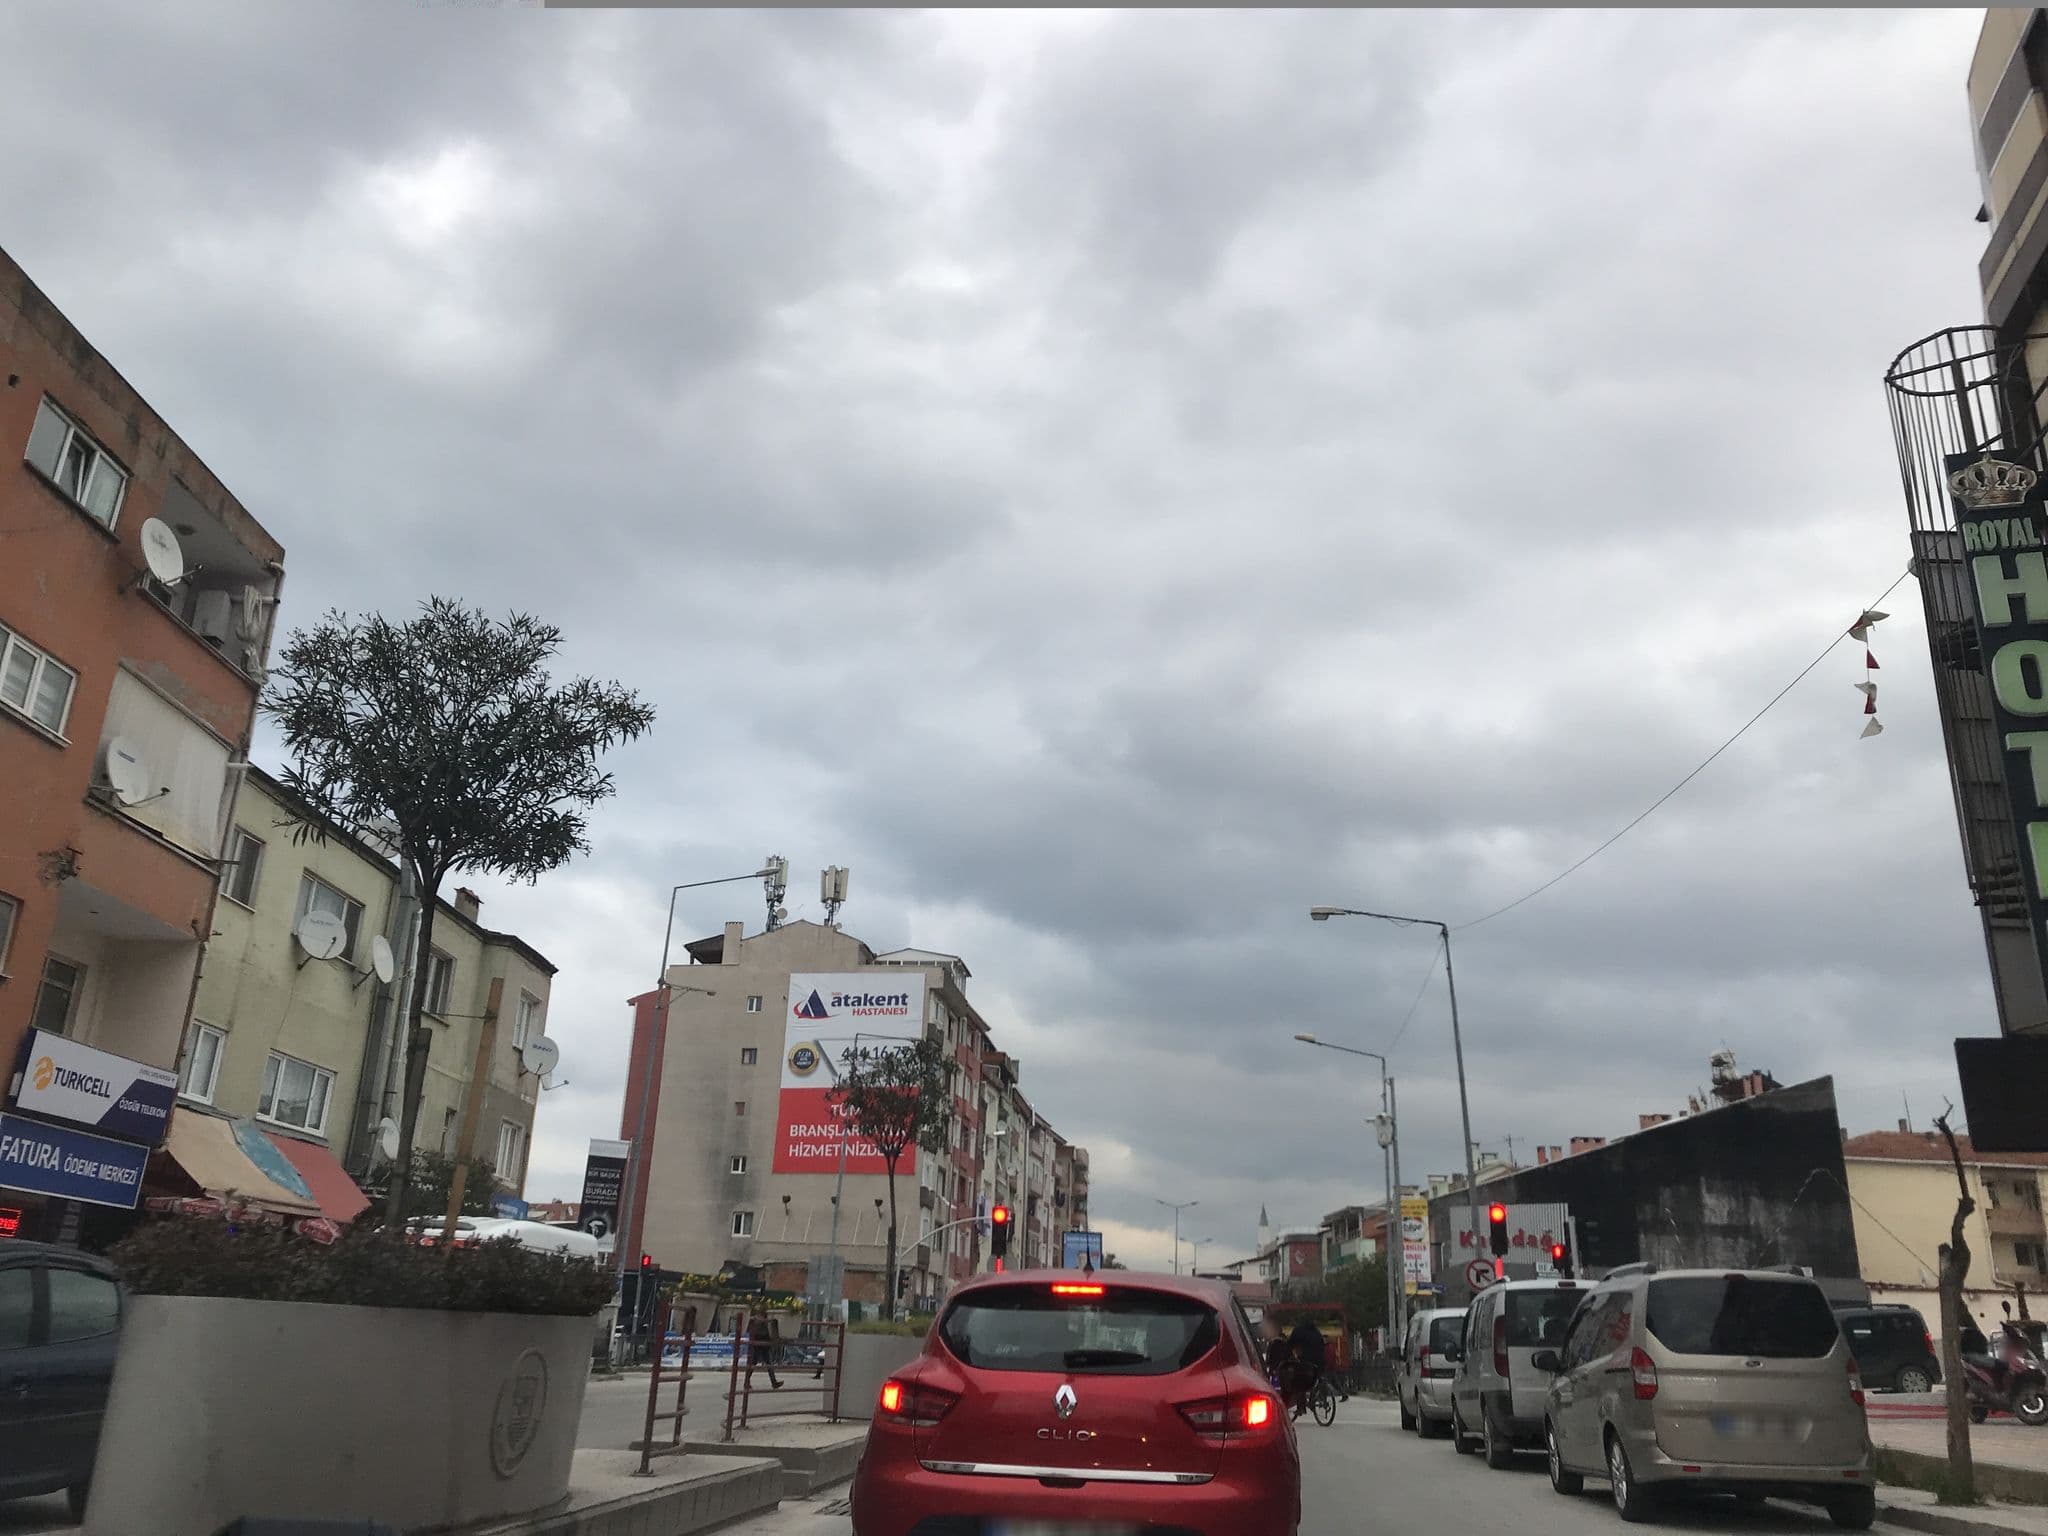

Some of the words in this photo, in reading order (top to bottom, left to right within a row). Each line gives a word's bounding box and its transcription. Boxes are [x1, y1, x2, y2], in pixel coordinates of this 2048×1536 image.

[1962, 516, 2041, 552] ROYAL
[831, 992, 909, 1007] atakent
[54, 1067, 111, 1098] TURKCELL
[119, 1096, 140, 1113] ÖZGÜR
[140, 1103, 167, 1119] TELEKOM
[0, 1134, 60, 1171] FATURA
[64, 1152, 99, 1178] ÖDEME
[99, 1163, 139, 1186] MERKEZİ
[1036, 1427, 1091, 1441] CLIO
